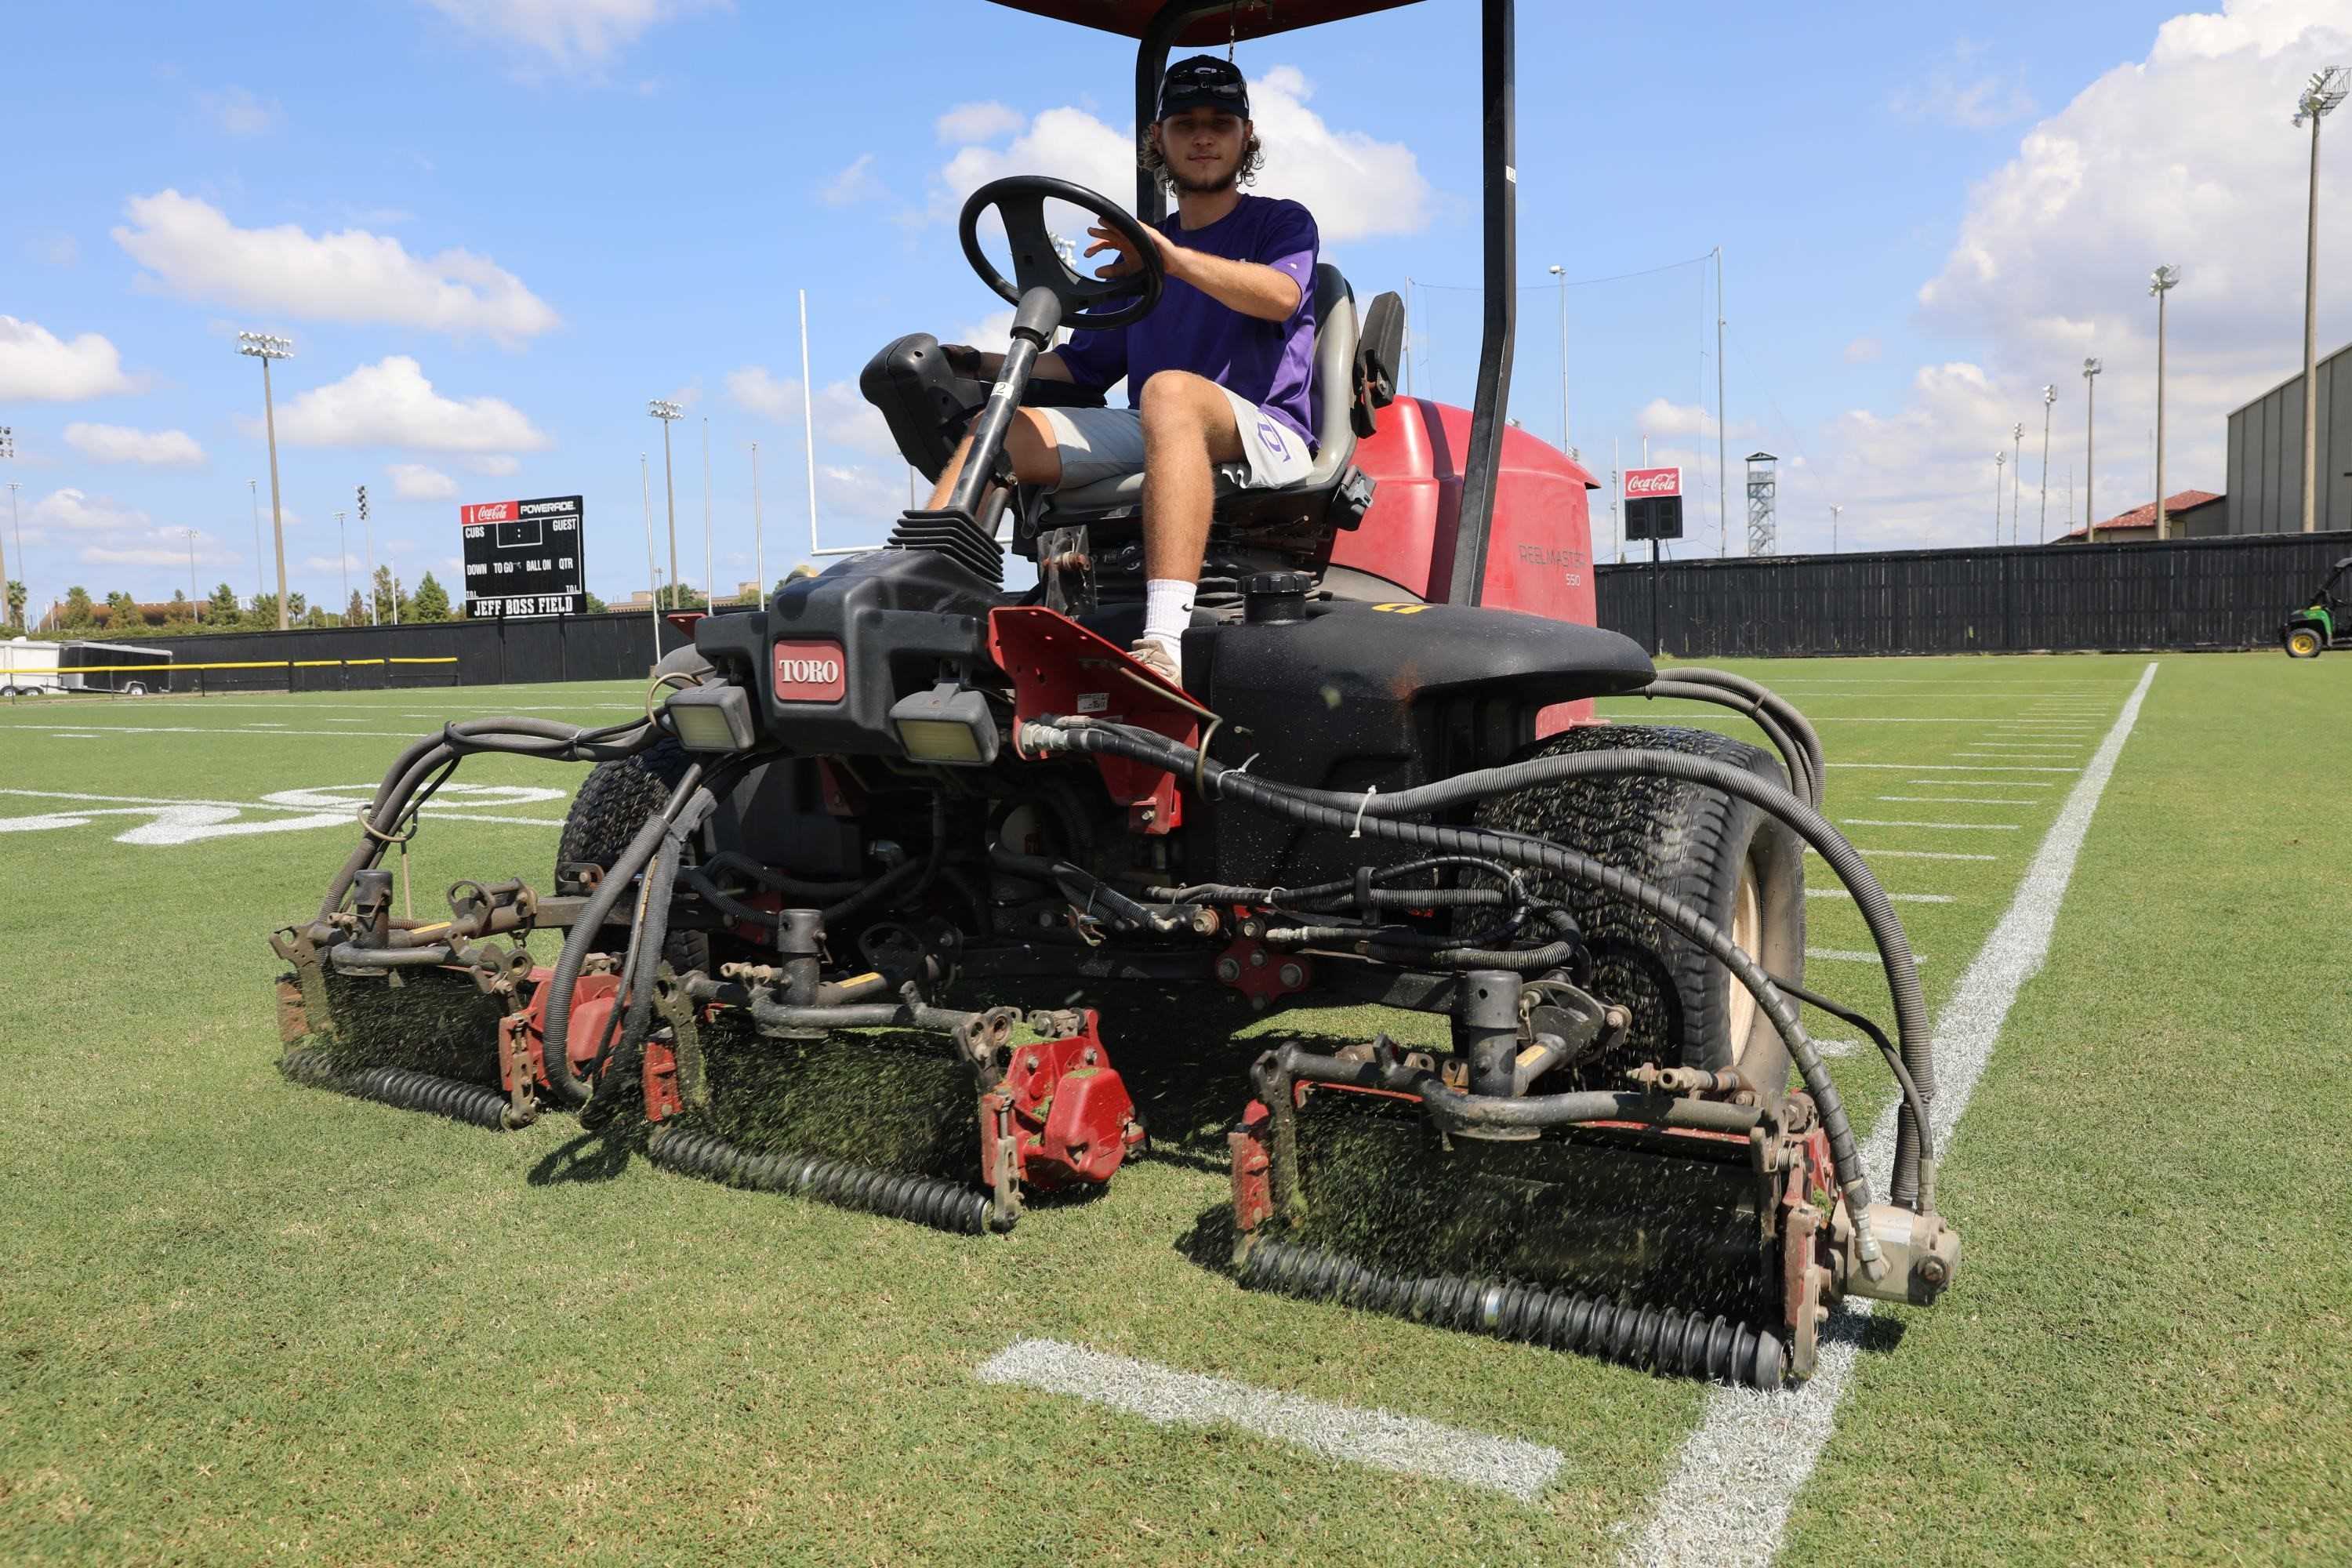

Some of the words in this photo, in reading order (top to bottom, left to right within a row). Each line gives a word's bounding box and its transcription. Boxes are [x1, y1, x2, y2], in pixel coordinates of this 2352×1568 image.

[521, 501, 574, 514] POWERADE
[553, 518, 576, 532] GUEST
[465, 526, 485, 539] CUBS
[466, 564, 487, 575] DOWN
[493, 563, 503, 574] TO
[504, 561, 514, 573] GO
[526, 560, 542, 572] BALL
[543, 559, 551, 570] ON
[559, 557, 573, 570] QTR
[474, 599, 502, 616] JEFF
[506, 598, 534, 615] BOSS
[538, 596, 573, 613] FIELD
[779, 660, 839, 683] TORO
